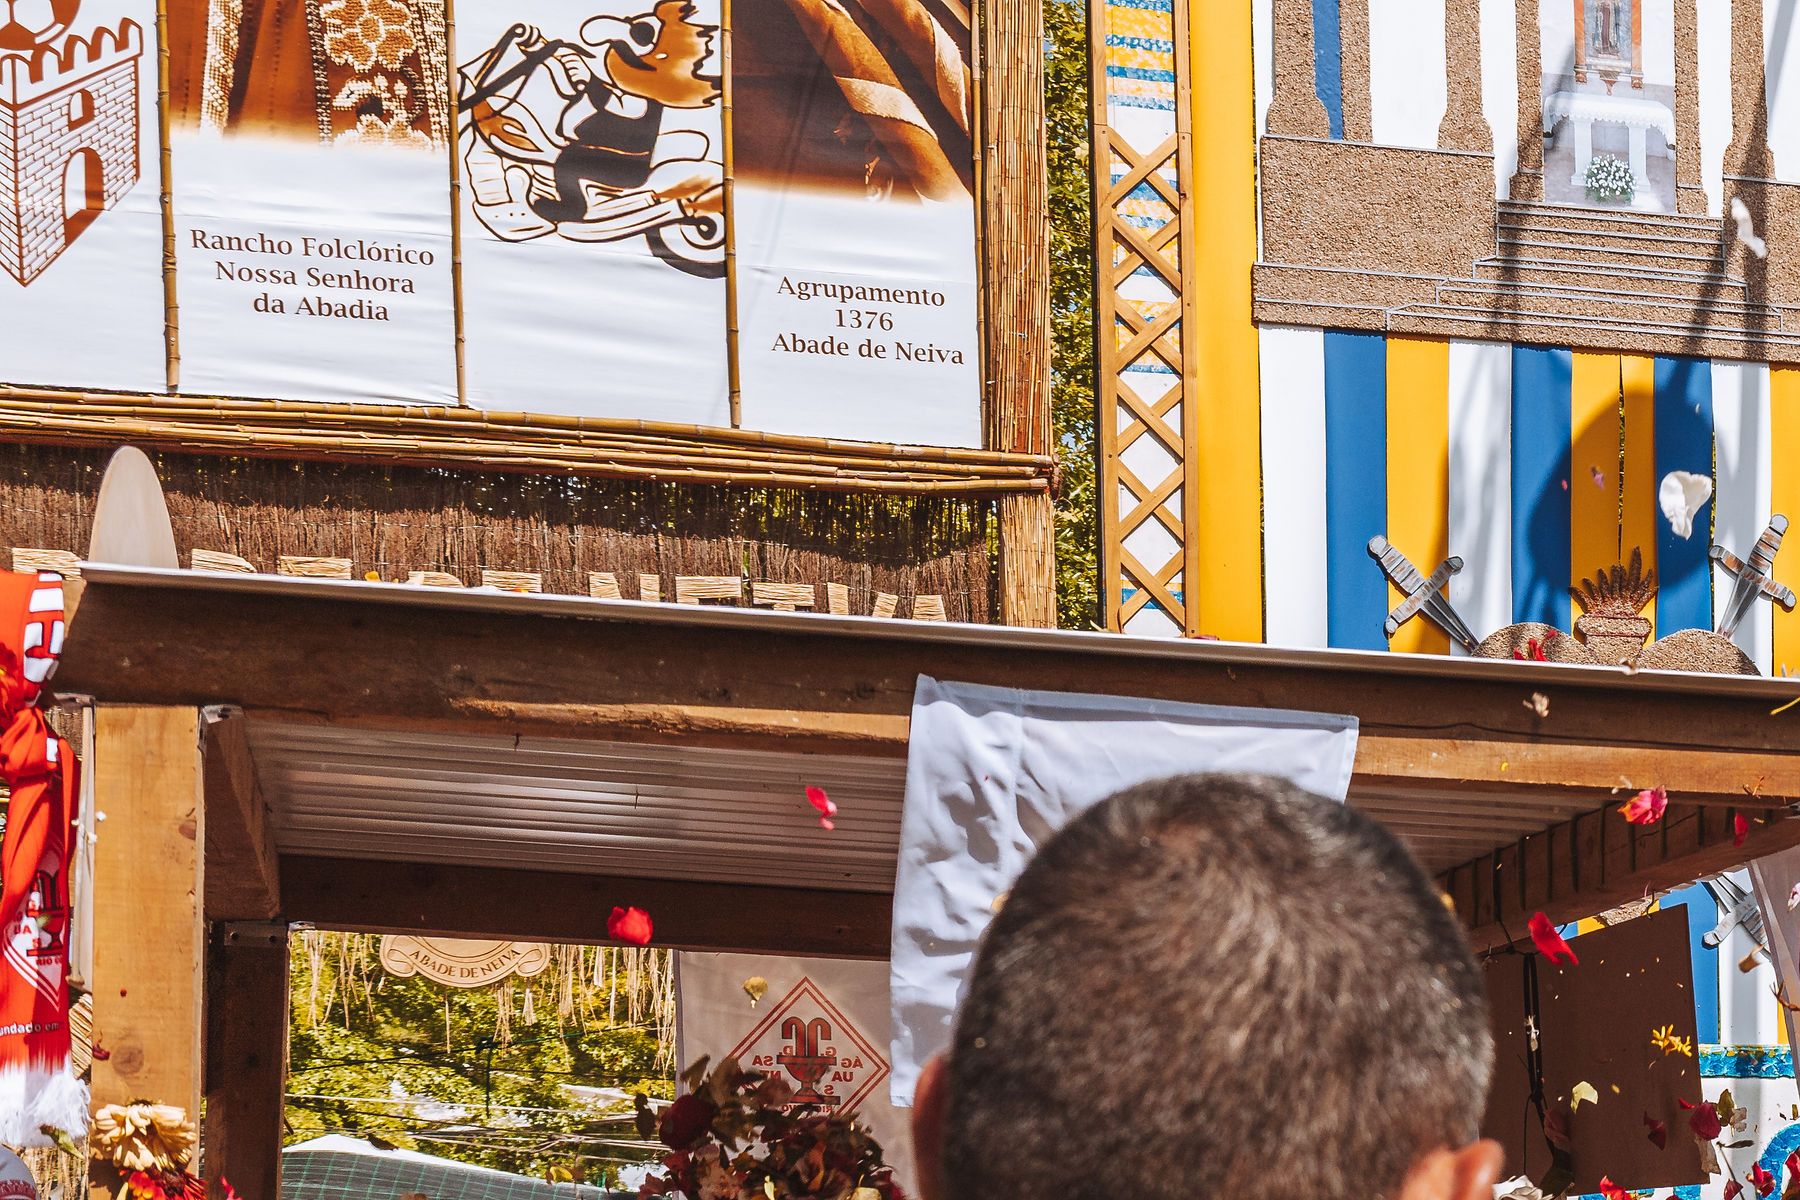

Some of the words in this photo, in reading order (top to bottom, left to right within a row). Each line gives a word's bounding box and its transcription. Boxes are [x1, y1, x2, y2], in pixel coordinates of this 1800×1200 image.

[190, 228, 293, 256] Rancho
[301, 236, 435, 267] Folclórico
[215, 260, 297, 286] Nossa
[306, 266, 415, 294] Senhora
[777, 275, 946, 307] Agrupamento
[253, 292, 286, 315] da
[294, 295, 390, 322] Abadia
[834, 308, 894, 332] 1376
[770, 332, 849, 357] Abade
[857, 338, 887, 359] de
[895, 341, 965, 365] Neiva
[408, 949, 456, 977] ABADE
[459, 967, 480, 978] DE
[480, 948, 522, 976] NEIVA
[0, 1021, 42, 1036] undado
